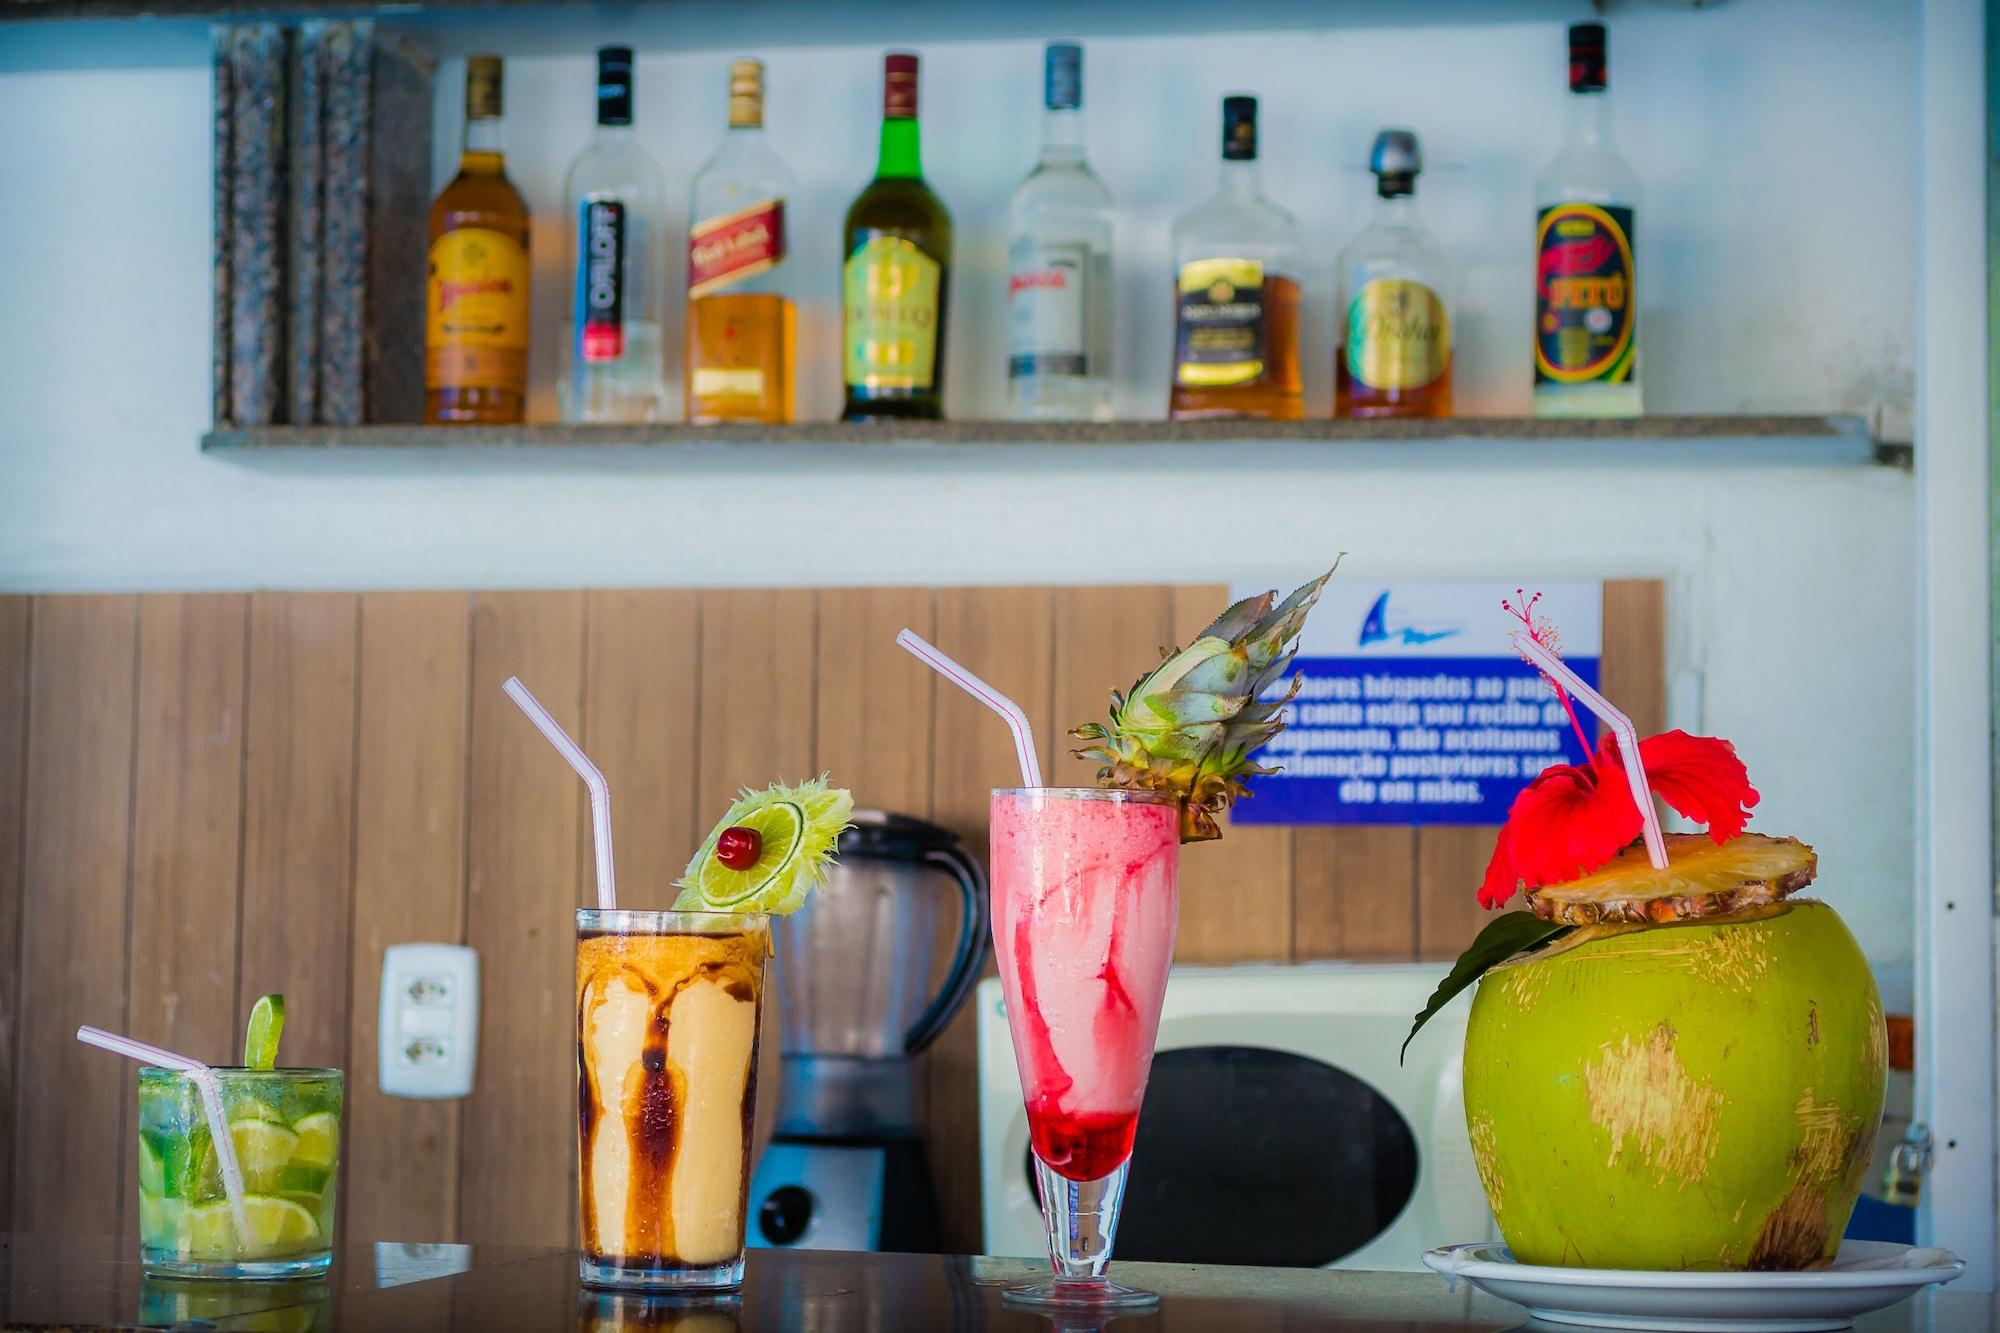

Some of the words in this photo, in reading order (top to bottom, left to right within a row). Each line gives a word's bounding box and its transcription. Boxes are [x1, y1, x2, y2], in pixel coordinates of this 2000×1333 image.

[1474, 677, 1503, 699] ao
[1301, 703, 1363, 725] conta
[1466, 702, 1540, 725] recibo
[1399, 726, 1441, 751] não
[1443, 728, 1561, 751] aceitamos
[1339, 781, 1377, 803] ele
[1379, 782, 1415, 803] em
